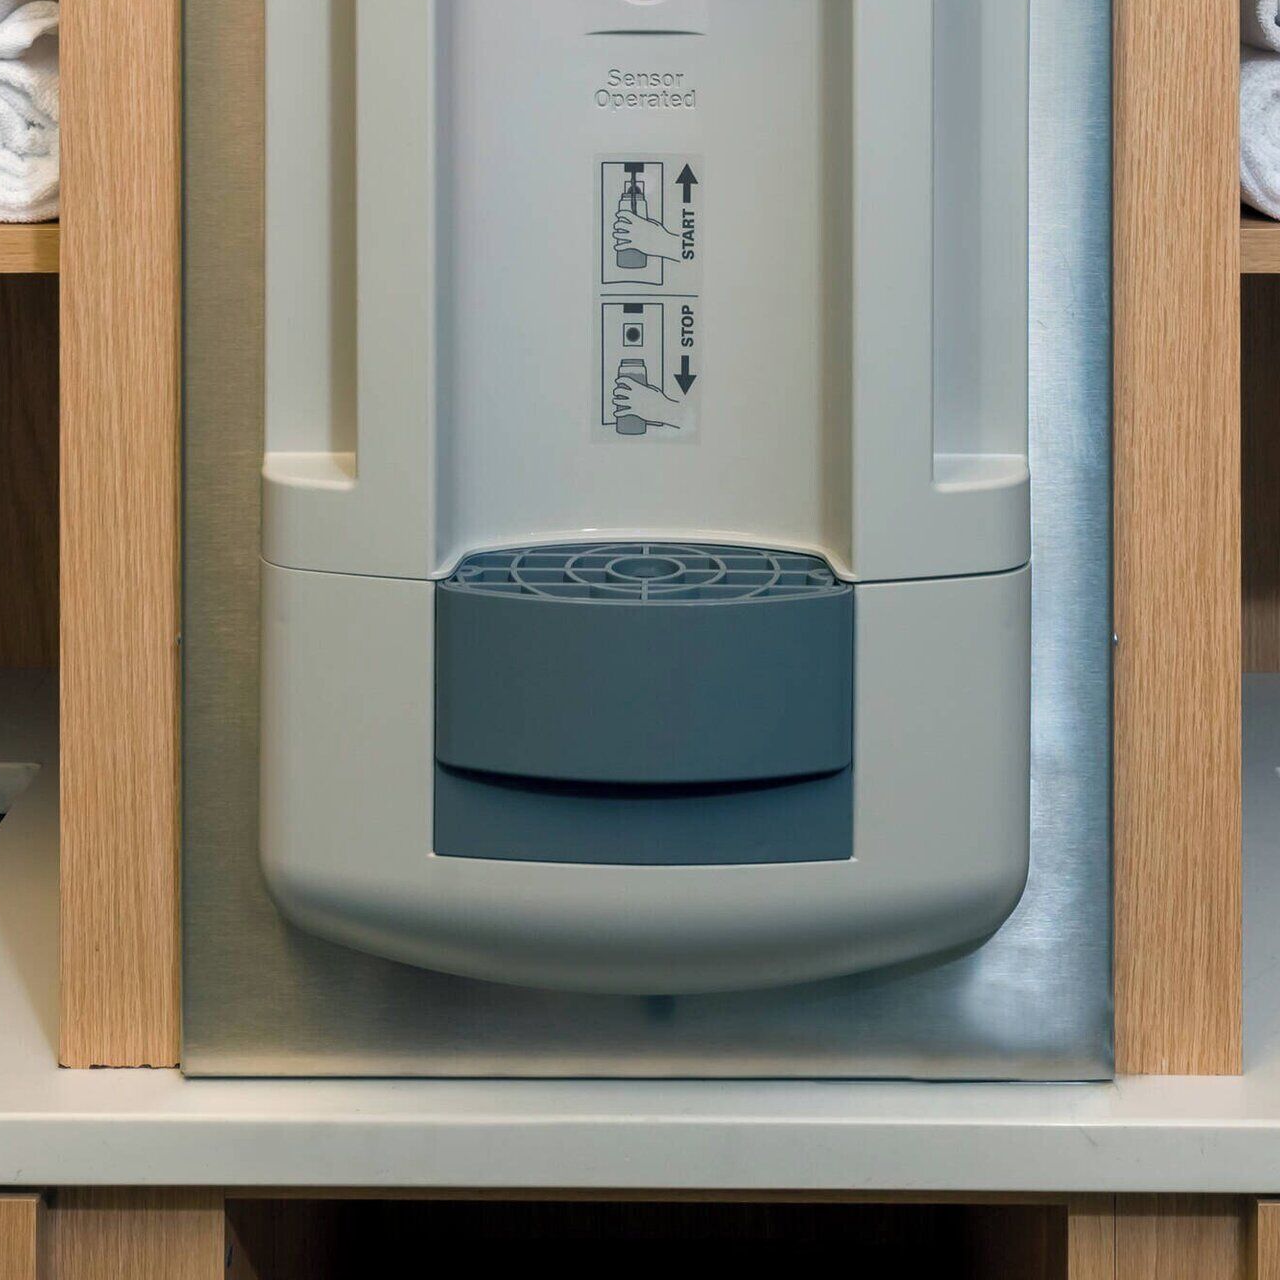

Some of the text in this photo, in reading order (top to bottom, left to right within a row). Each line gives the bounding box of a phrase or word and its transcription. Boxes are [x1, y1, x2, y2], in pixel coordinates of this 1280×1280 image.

[607, 69, 684, 87] Sensor
[593, 88, 696, 112] Operated
[681, 208, 696, 260] START
[680, 305, 695, 348] STOP
